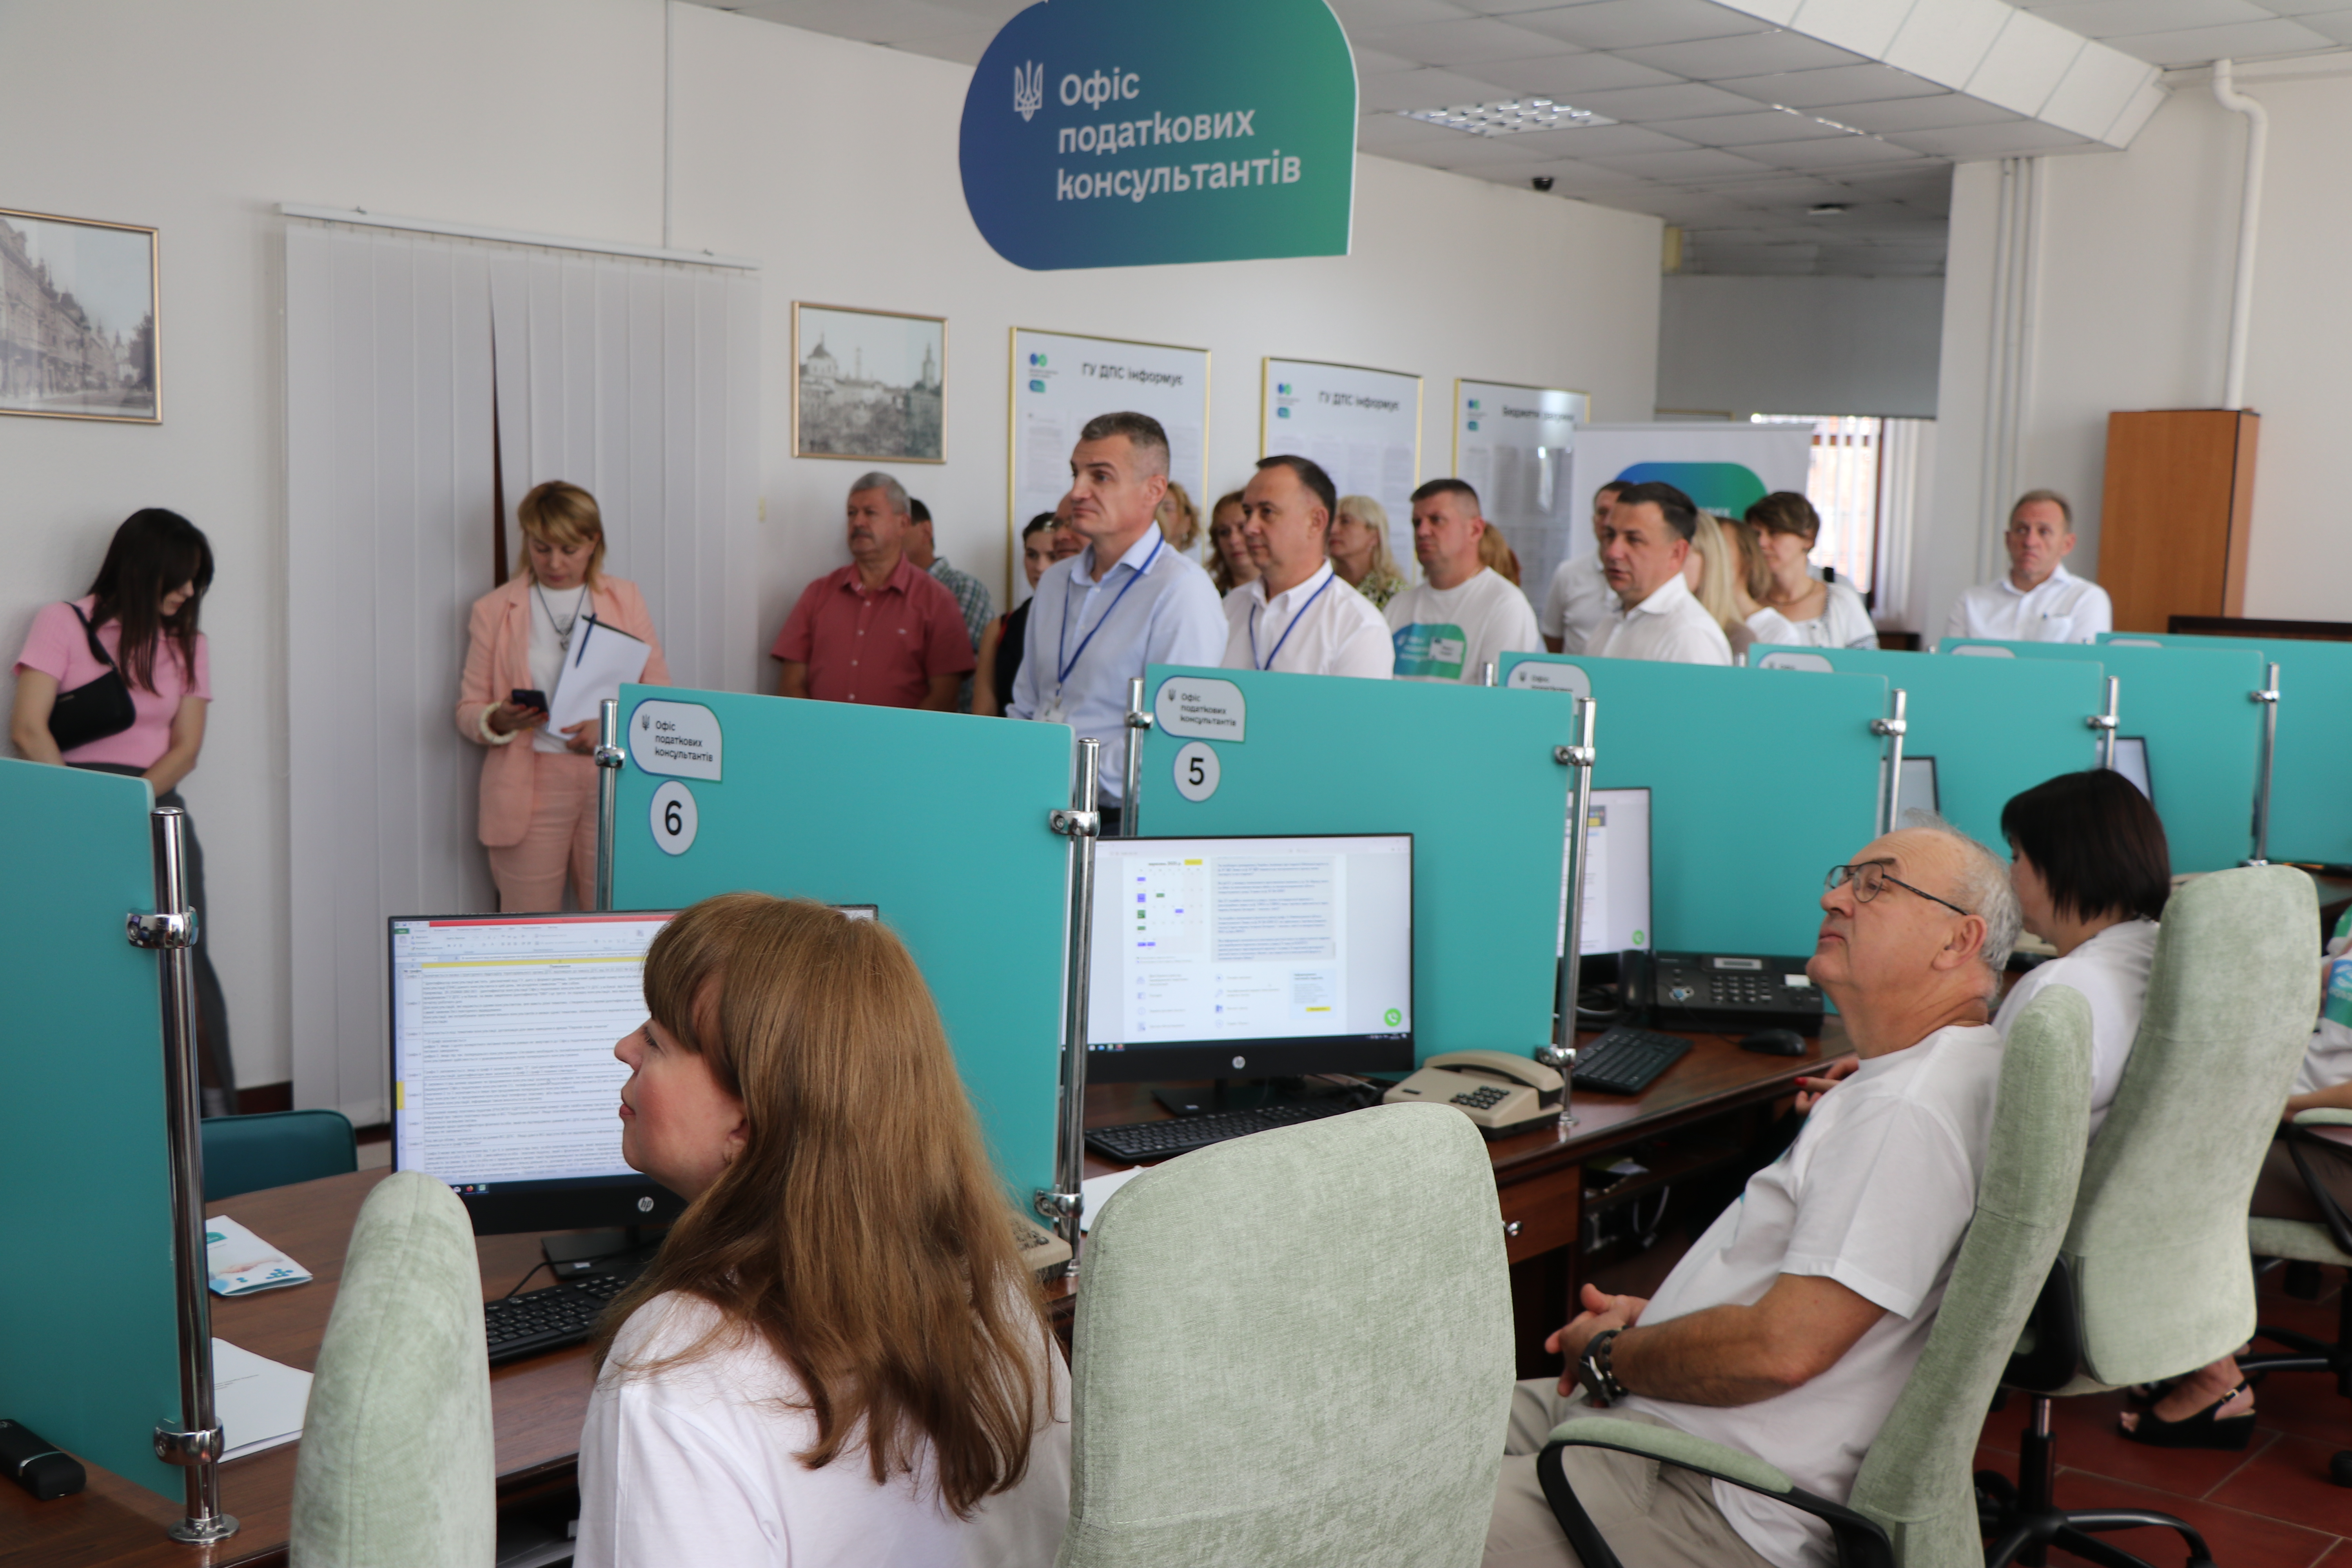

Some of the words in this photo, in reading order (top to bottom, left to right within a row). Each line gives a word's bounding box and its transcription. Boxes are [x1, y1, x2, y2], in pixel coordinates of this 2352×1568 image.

[1059, 67, 1140, 110] Офіс
[1058, 109, 1255, 155] податкових
[1056, 149, 1301, 203] консультантів
[1100, 364, 1124, 379] ДПС
[1127, 367, 1183, 387] інформує
[1181, 693, 1201, 702] Офіс
[1181, 705, 1227, 714] податкових
[655, 720, 676, 731] Офіс
[1180, 714, 1236, 726] консультантів
[655, 735, 703, 747] податкових
[655, 747, 713, 762] консультантів
[1189, 757, 1204, 786] 5
[665, 800, 682, 835] 6
[640, 1197, 653, 1212] hp
